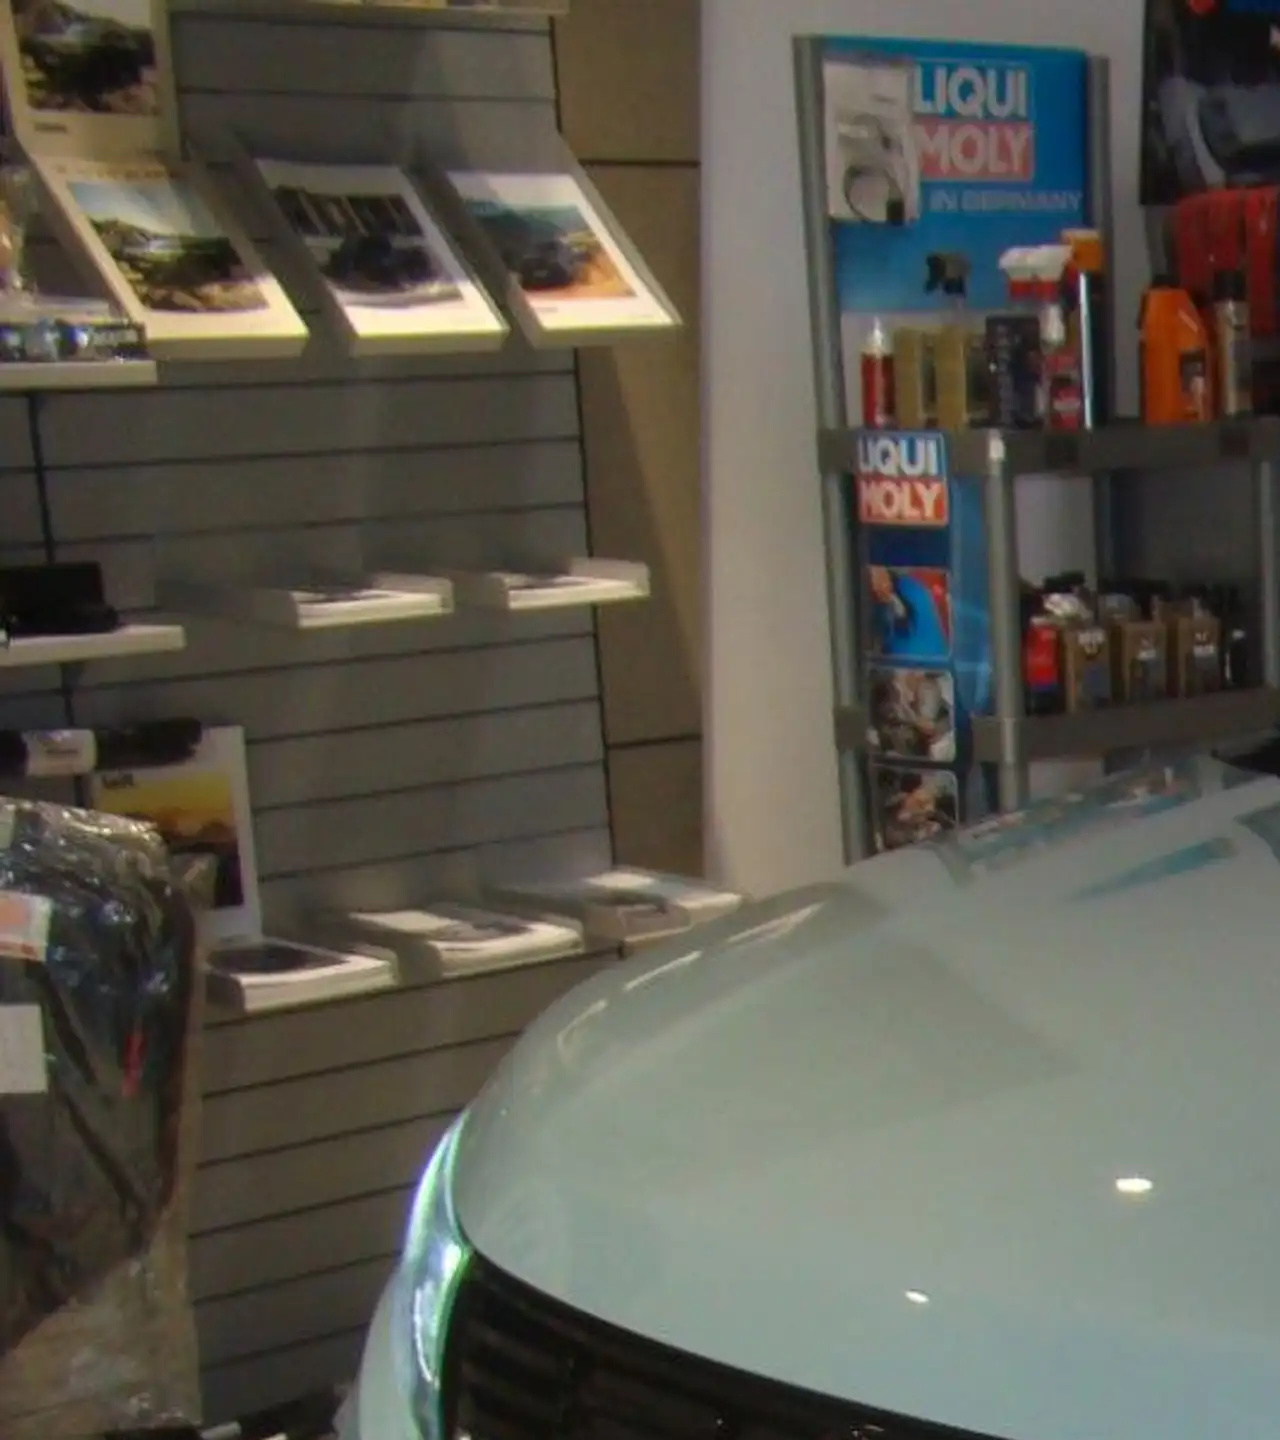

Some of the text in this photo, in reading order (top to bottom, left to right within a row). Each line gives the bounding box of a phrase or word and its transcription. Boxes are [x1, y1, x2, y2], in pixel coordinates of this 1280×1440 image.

[911, 64, 1027, 120] LIQUI
[910, 123, 1030, 175] MOLY
[857, 436, 938, 478] LIQUI
[861, 480, 942, 520] MOLY
